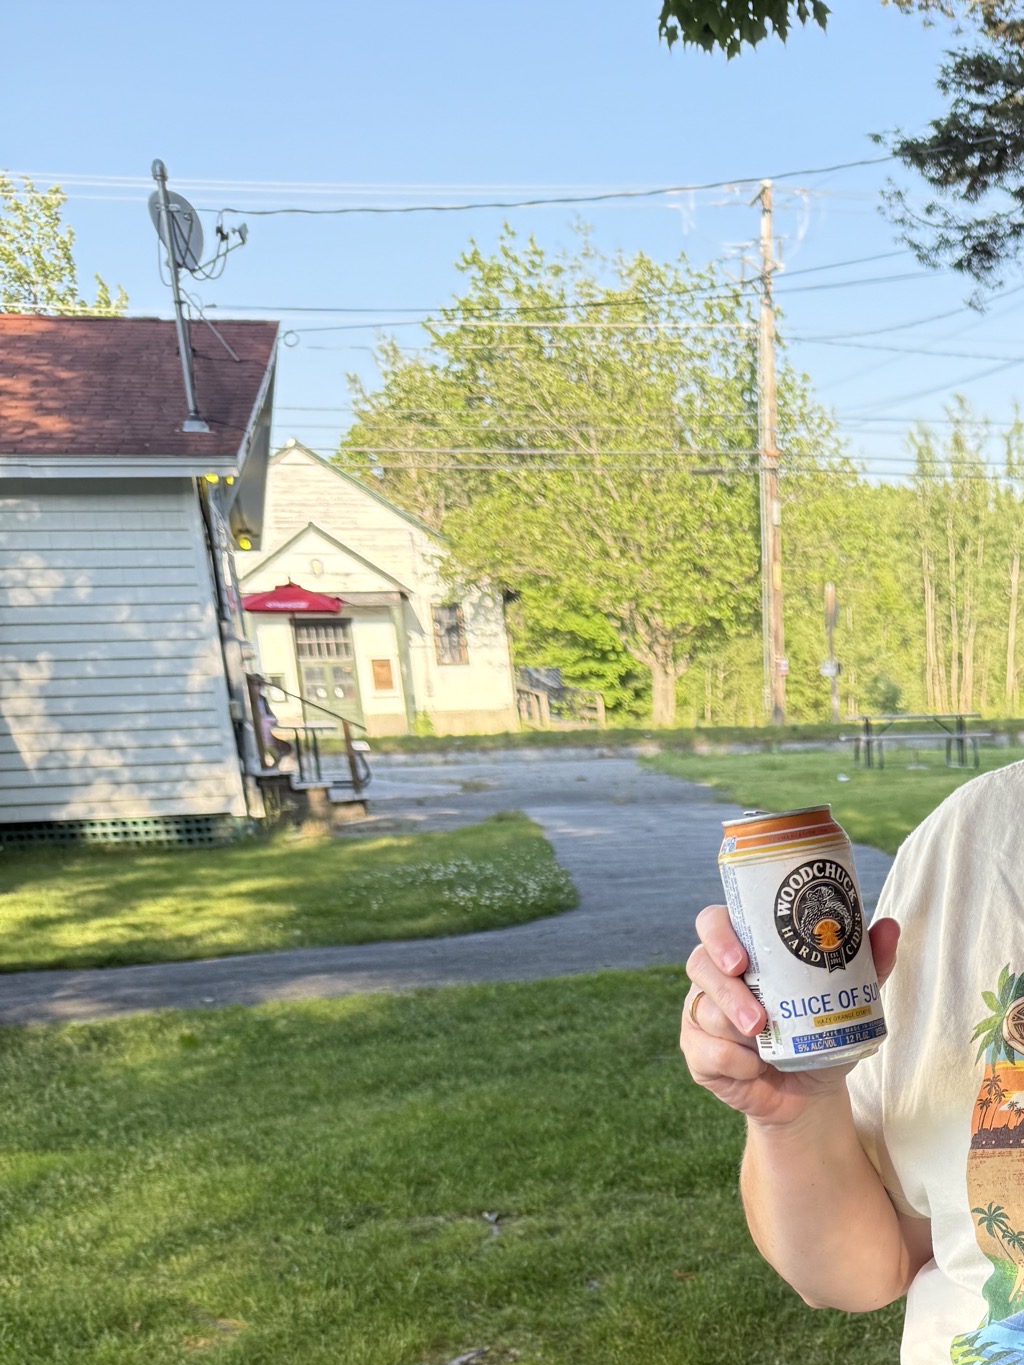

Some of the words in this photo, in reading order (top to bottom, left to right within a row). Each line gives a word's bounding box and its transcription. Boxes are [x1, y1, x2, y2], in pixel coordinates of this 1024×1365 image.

[777, 862, 857, 917] WOODCHUCK
[782, 926, 821, 962] HARD
[846, 912, 861, 955] CIDER
[780, 993, 834, 1019] SLICE
[838, 987, 859, 1009] OF
[797, 1044, 810, 1053] 5%
[811, 1039, 837, 1051] ALC/VOL
[845, 1034, 855, 1044] 12
